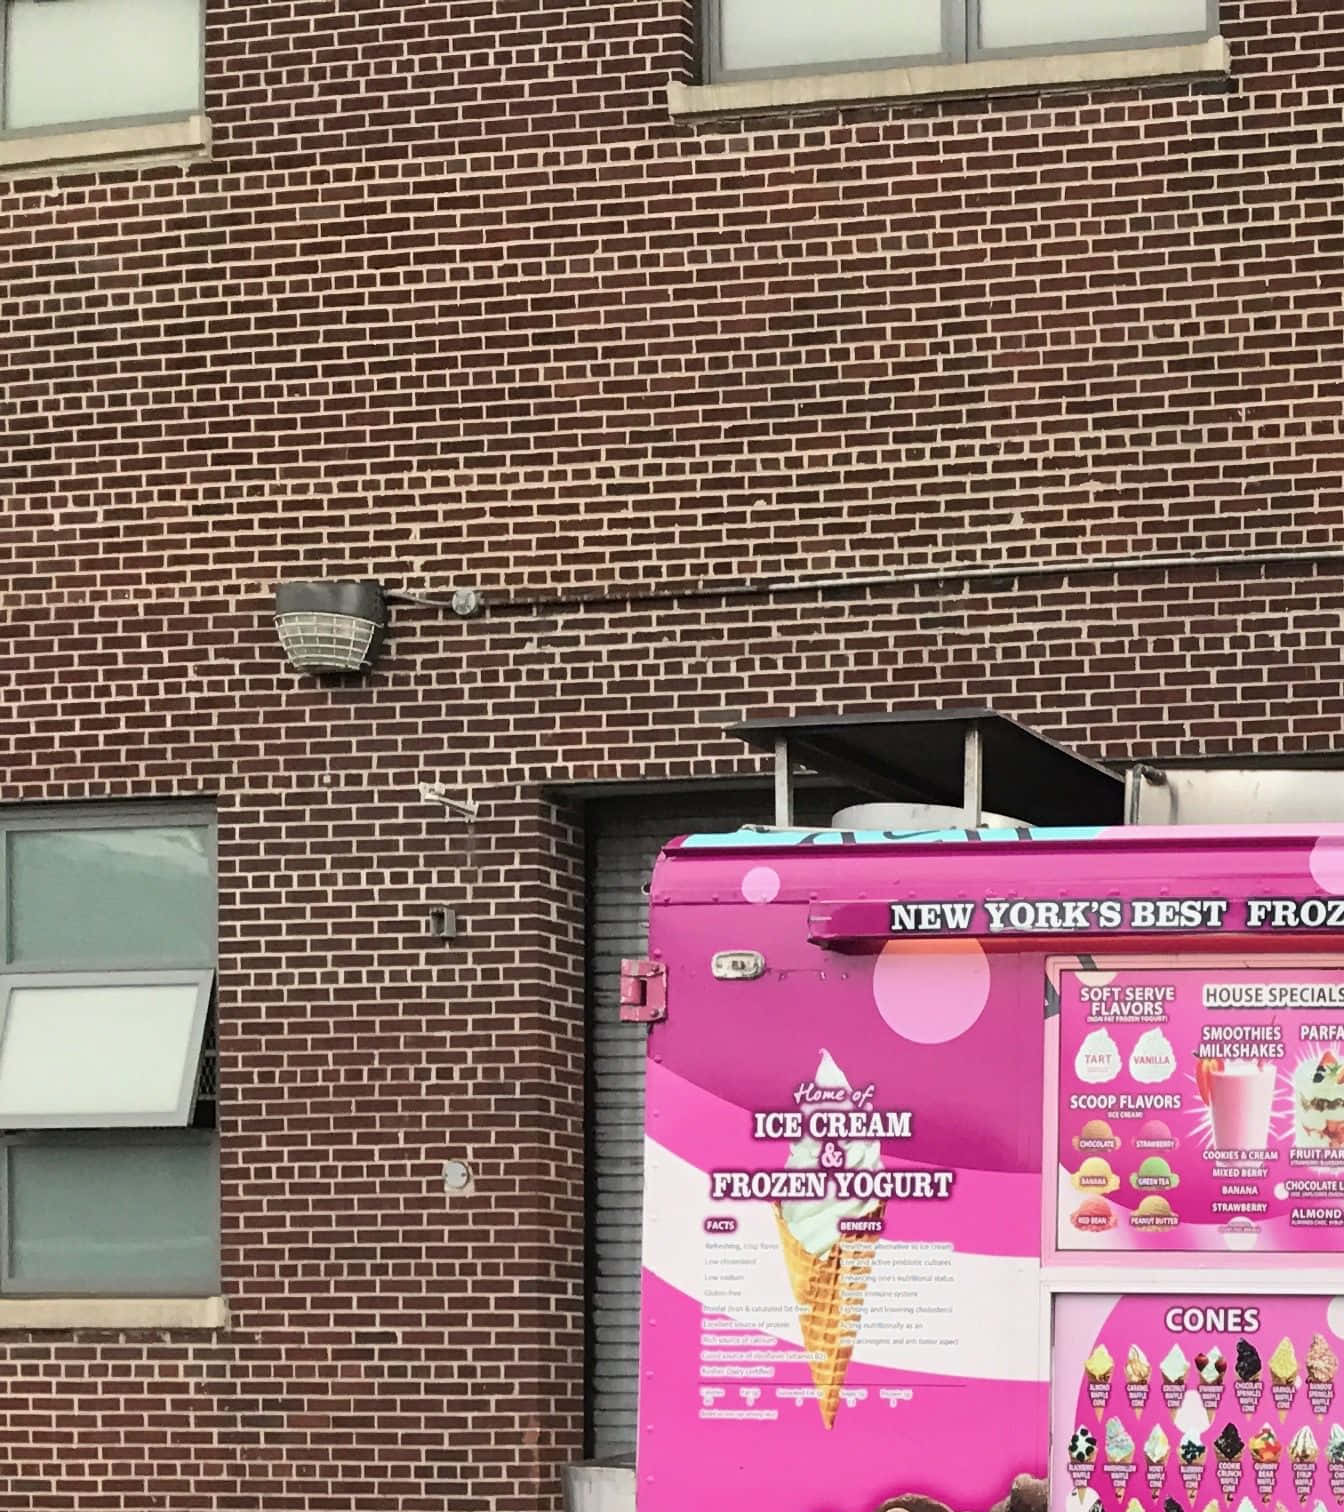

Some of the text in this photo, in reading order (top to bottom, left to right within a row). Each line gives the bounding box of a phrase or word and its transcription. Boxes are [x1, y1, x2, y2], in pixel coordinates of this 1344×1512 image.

[892, 903, 974, 931] NEW
[984, 901, 1121, 931] YORK'S
[1131, 900, 1227, 928] BEST
[1080, 986, 1175, 1001] SOFT SERVE
[1206, 986, 1263, 1002] HOUSE
[1091, 1001, 1164, 1016] FLAVORS
[1203, 1026, 1281, 1041] SMOOTHIES
[1200, 1043, 1285, 1059] MILKSHAKES
[1085, 1054, 1111, 1064] TART
[1134, 1055, 1170, 1065] VANILLA
[794, 1084, 875, 1108] Home of
[1070, 1094, 1182, 1109] SCOOP FLAVORS
[755, 1112, 912, 1138] ICE CREAM
[1079, 1139, 1175, 1149] CHOCOLATE STRAWBERRY
[821, 1142, 843, 1168] &
[1203, 1151, 1239, 1160] COOKIES
[1248, 1151, 1278, 1160] CREAM
[1290, 1150, 1321, 1159] FRUIT
[1212, 1168, 1268, 1177] MIXED BERRY
[713, 1172, 953, 1197] FROZEN YOGURT
[1222, 1186, 1258, 1195] BANANA
[1285, 1181, 1337, 1191] CHOCOLATE
[1212, 1202, 1268, 1213] STRAWBERRY
[1292, 1208, 1342, 1219] ALMOND
[706, 1220, 735, 1230] FACTS
[840, 1221, 882, 1231] BENEFITS
[1165, 1308, 1260, 1332] CONES
